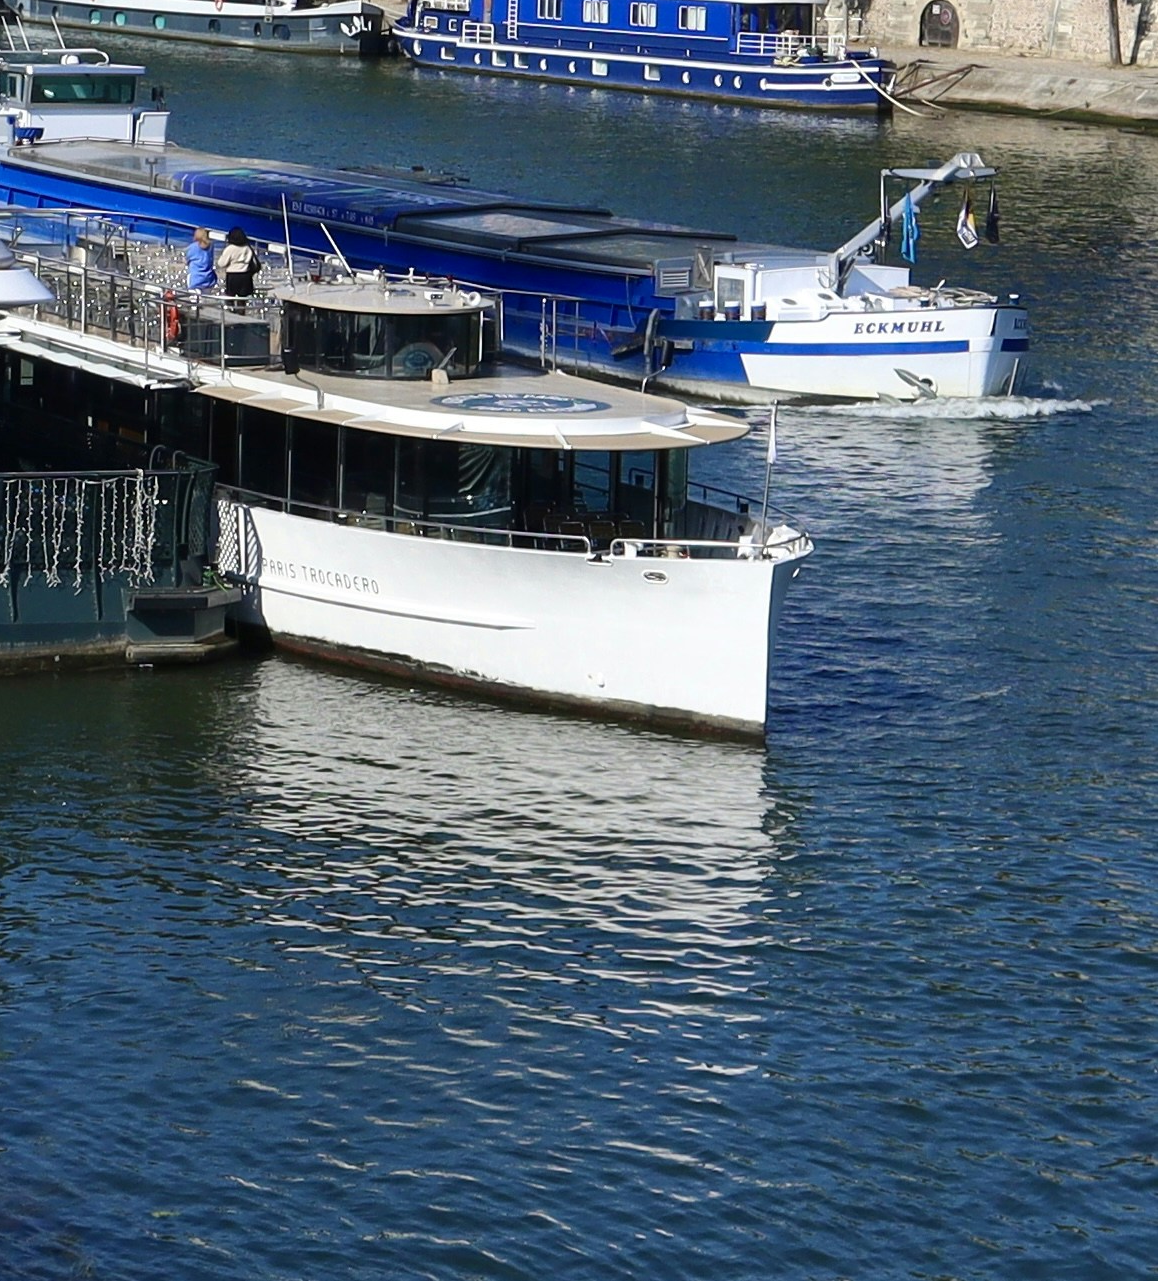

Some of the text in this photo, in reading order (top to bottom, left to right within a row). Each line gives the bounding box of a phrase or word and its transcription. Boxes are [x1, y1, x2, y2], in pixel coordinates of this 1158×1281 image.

[854, 320, 945, 335] ECKMUHL
[262, 558, 379, 595] PARIS TROCADERO
